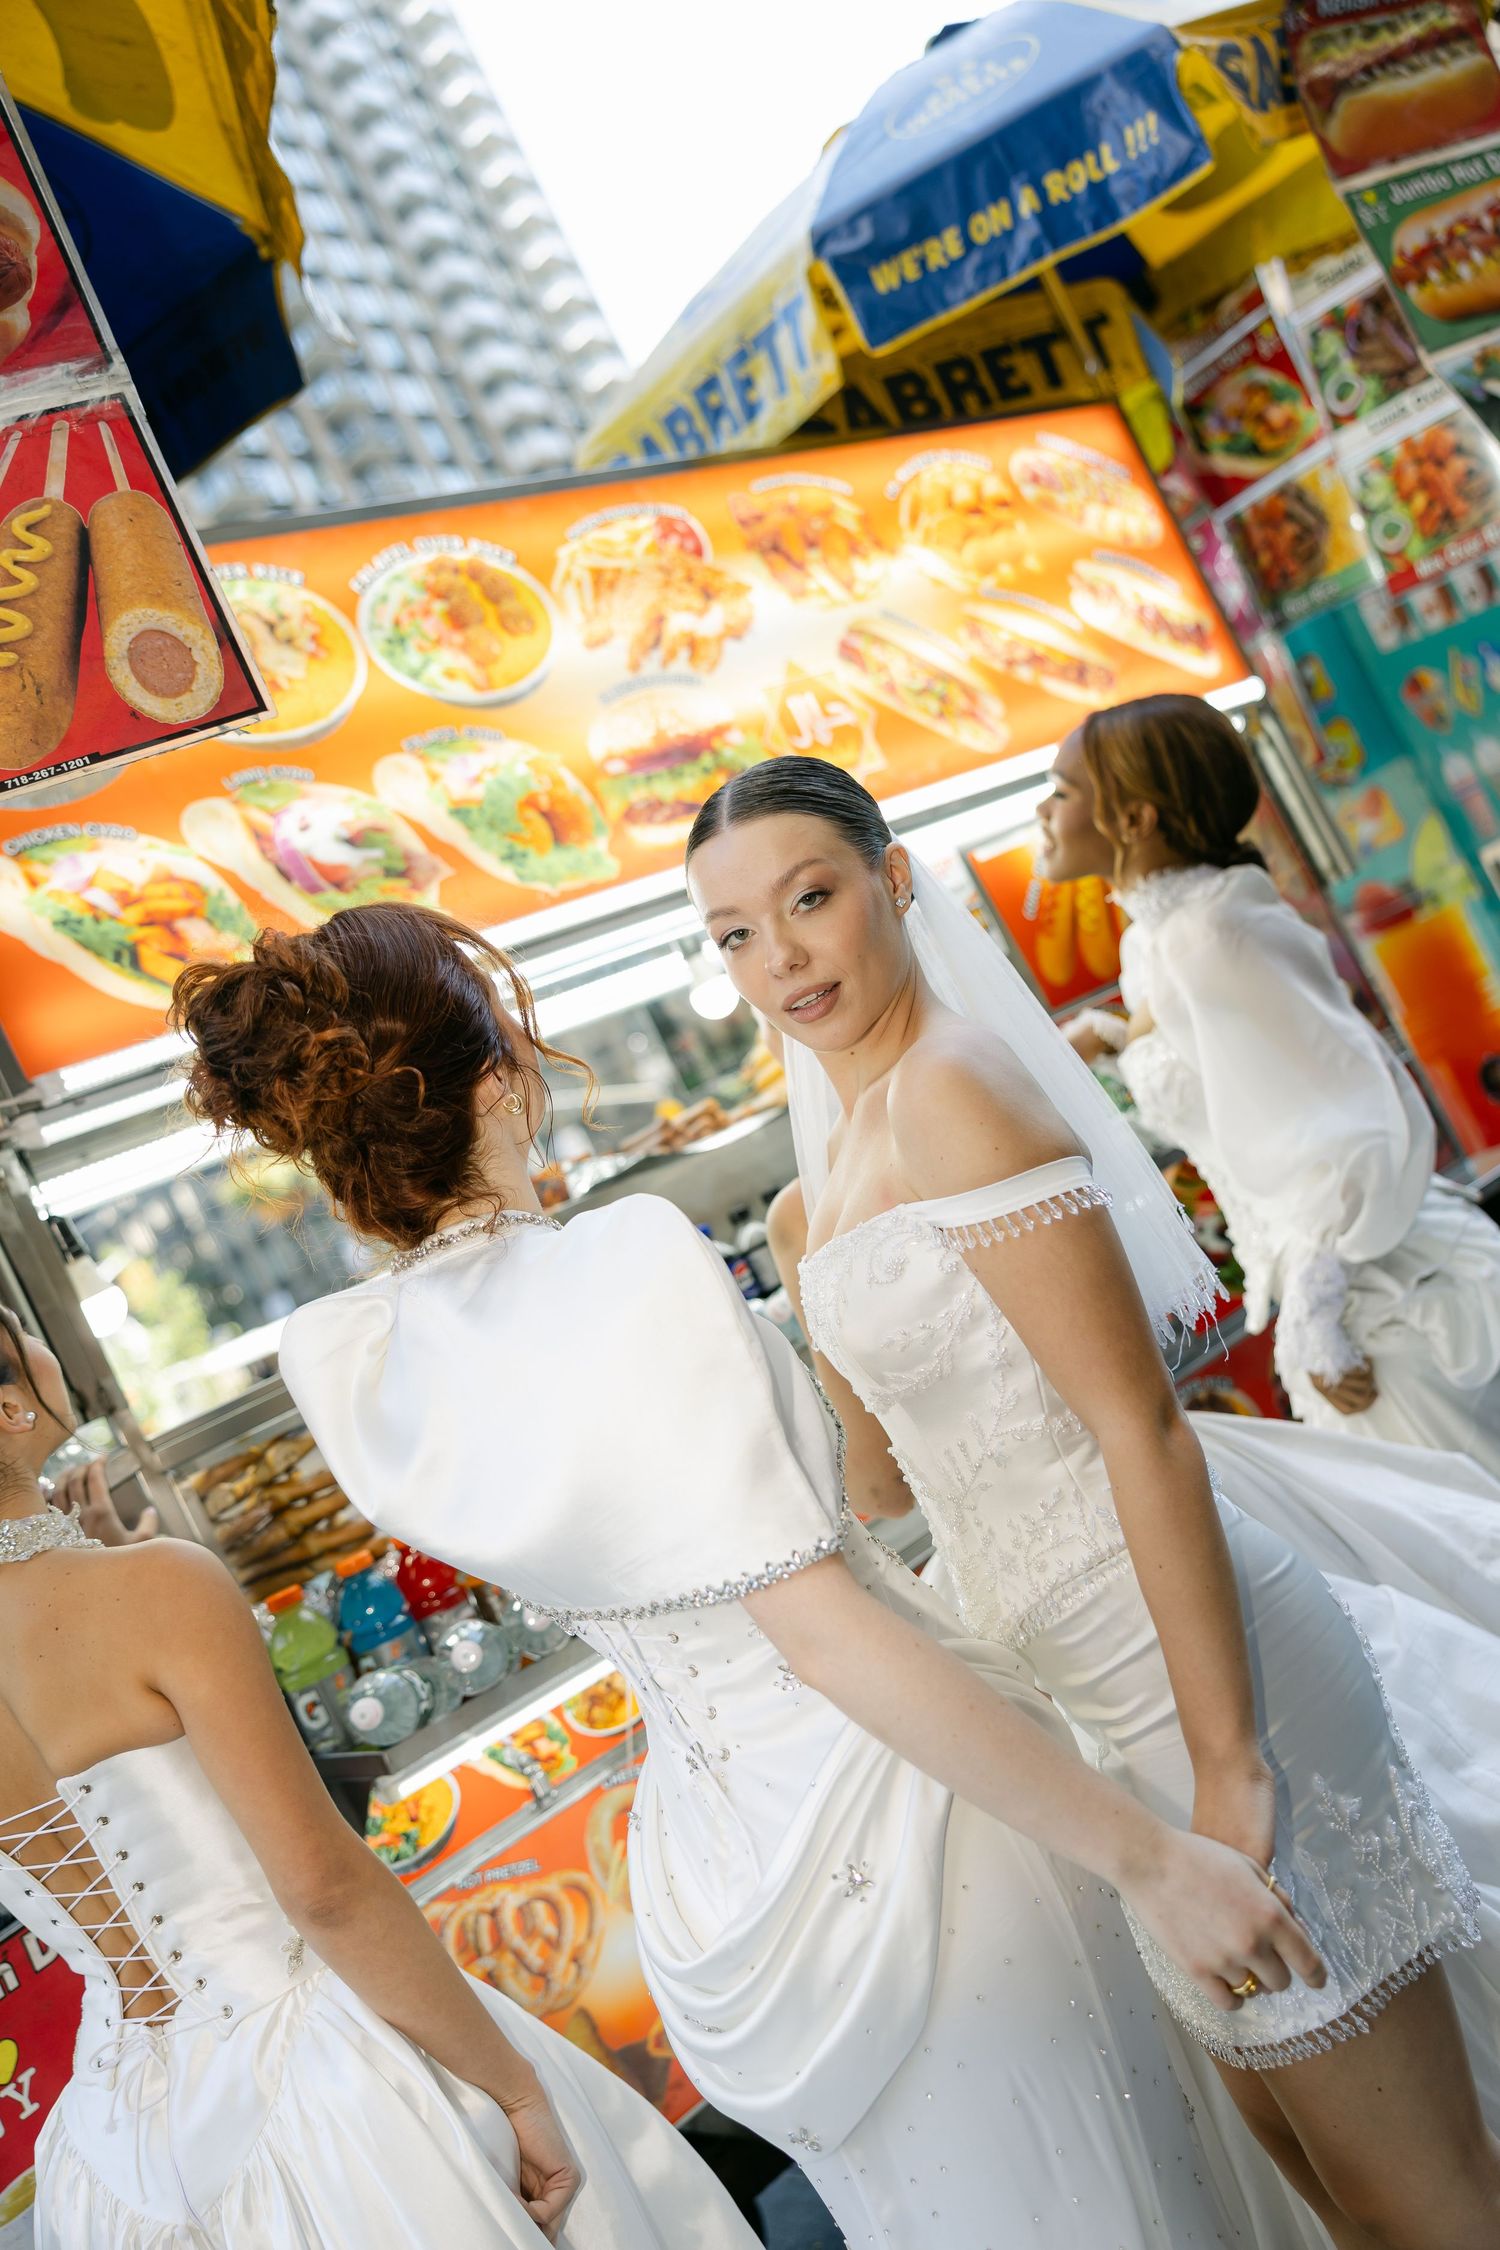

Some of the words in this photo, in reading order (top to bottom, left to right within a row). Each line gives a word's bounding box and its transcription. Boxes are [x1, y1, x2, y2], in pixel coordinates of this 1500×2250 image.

[869, 226, 967, 295] WE'RE
[968, 198, 1015, 246] ON
[1018, 184, 1042, 219] A
[1042, 142, 1121, 207] ROLL
[1123, 111, 1161, 160] !!!
[611, 294, 814, 470] ABRETT
[4, 756, 92, 789] 718-267-1201
[2, 823, 82, 856] CHICKEN
[83, 822, 138, 841] GYRO
[296, 1690, 331, 1731] G
